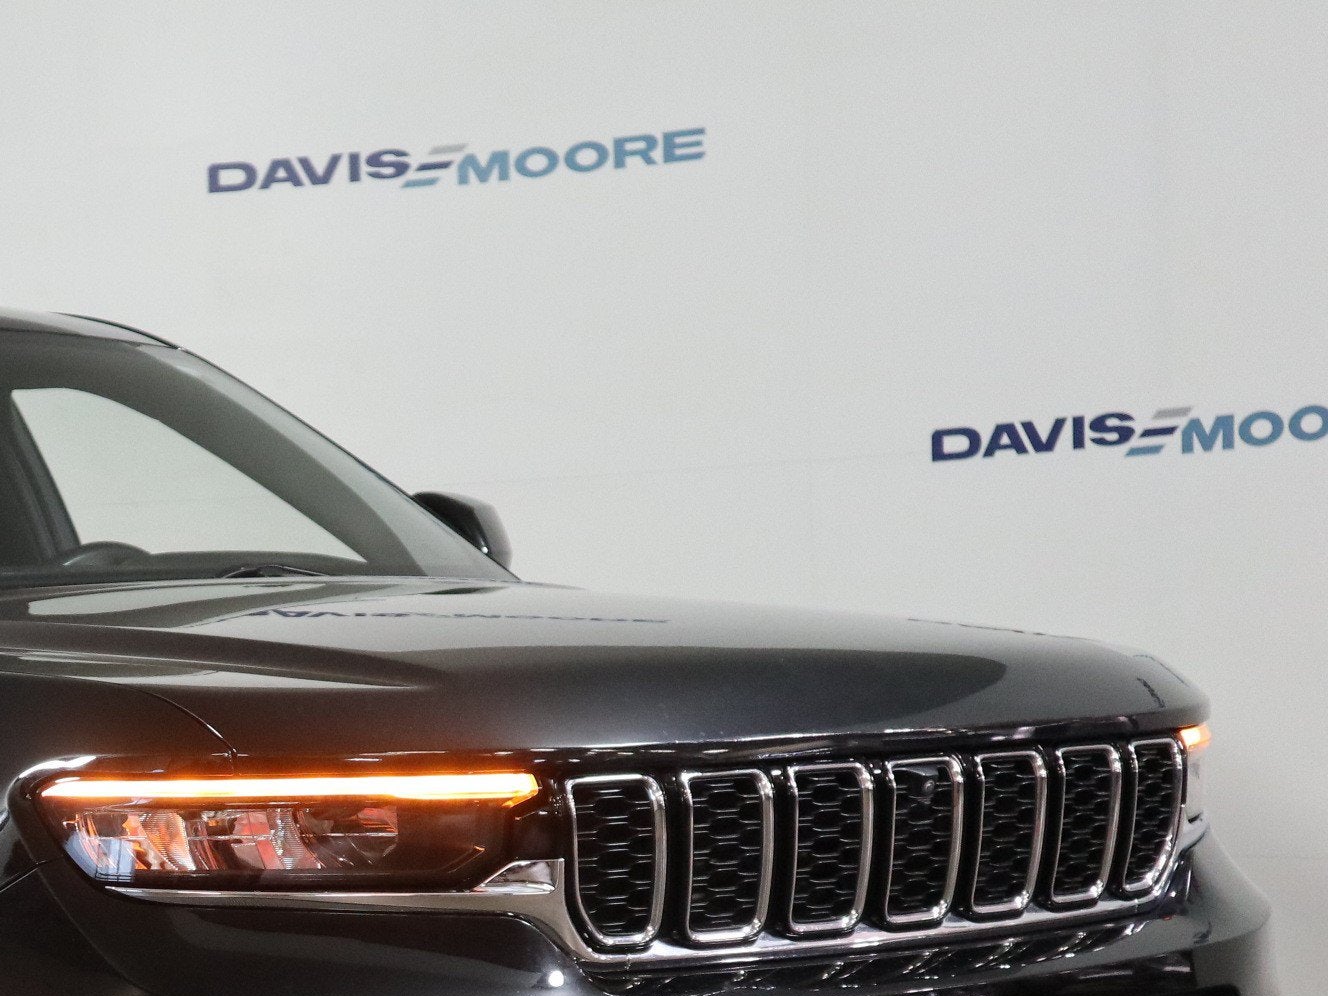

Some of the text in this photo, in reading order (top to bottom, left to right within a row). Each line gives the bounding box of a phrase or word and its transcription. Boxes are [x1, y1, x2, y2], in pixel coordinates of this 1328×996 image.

[207, 127, 706, 194] DAVIS MOORE
[931, 411, 1136, 462] DAVIS
